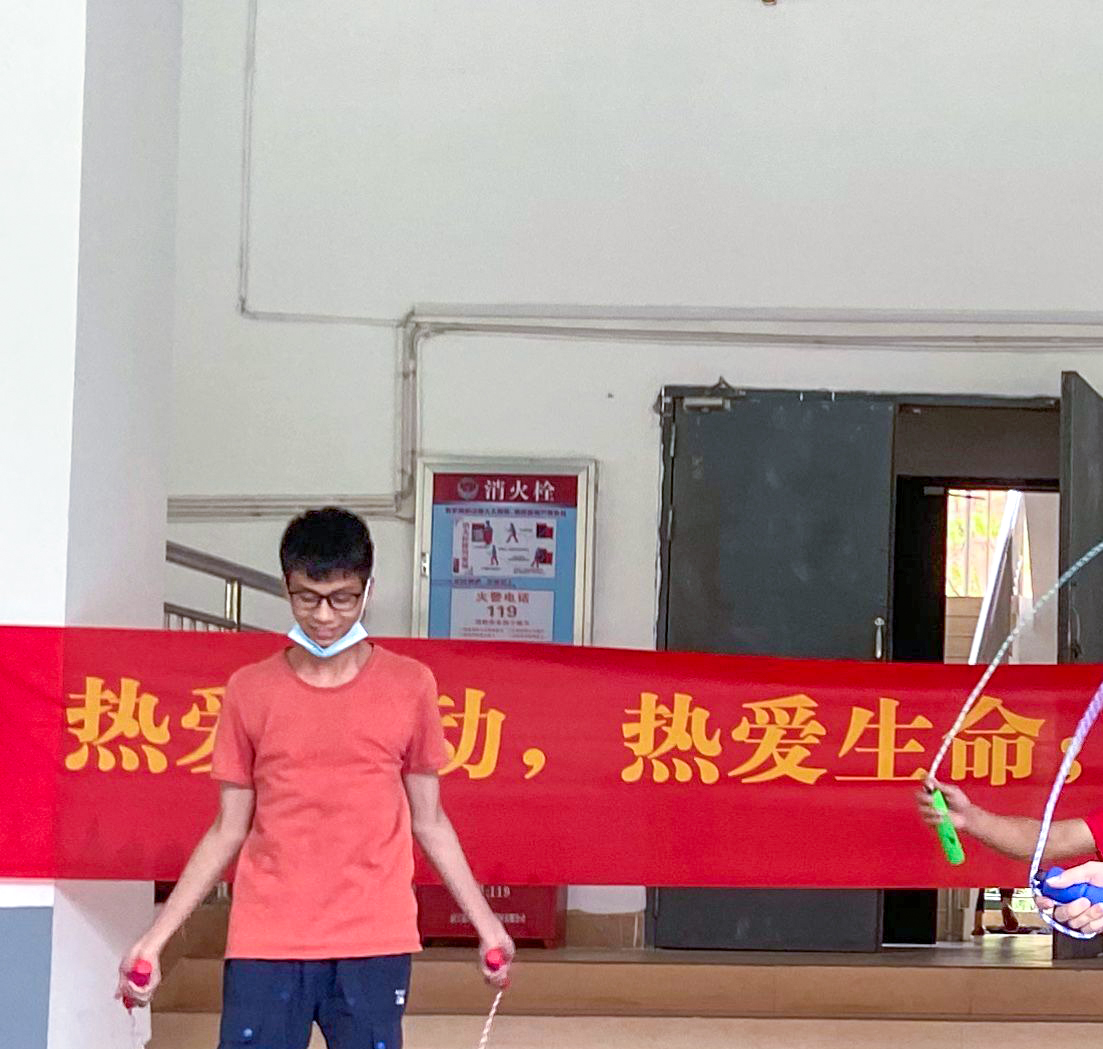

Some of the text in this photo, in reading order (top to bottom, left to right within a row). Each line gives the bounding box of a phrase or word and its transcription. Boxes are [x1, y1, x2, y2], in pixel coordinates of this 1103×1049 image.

[484, 479, 556, 502] 消火栓
[487, 605, 518, 618] 119
